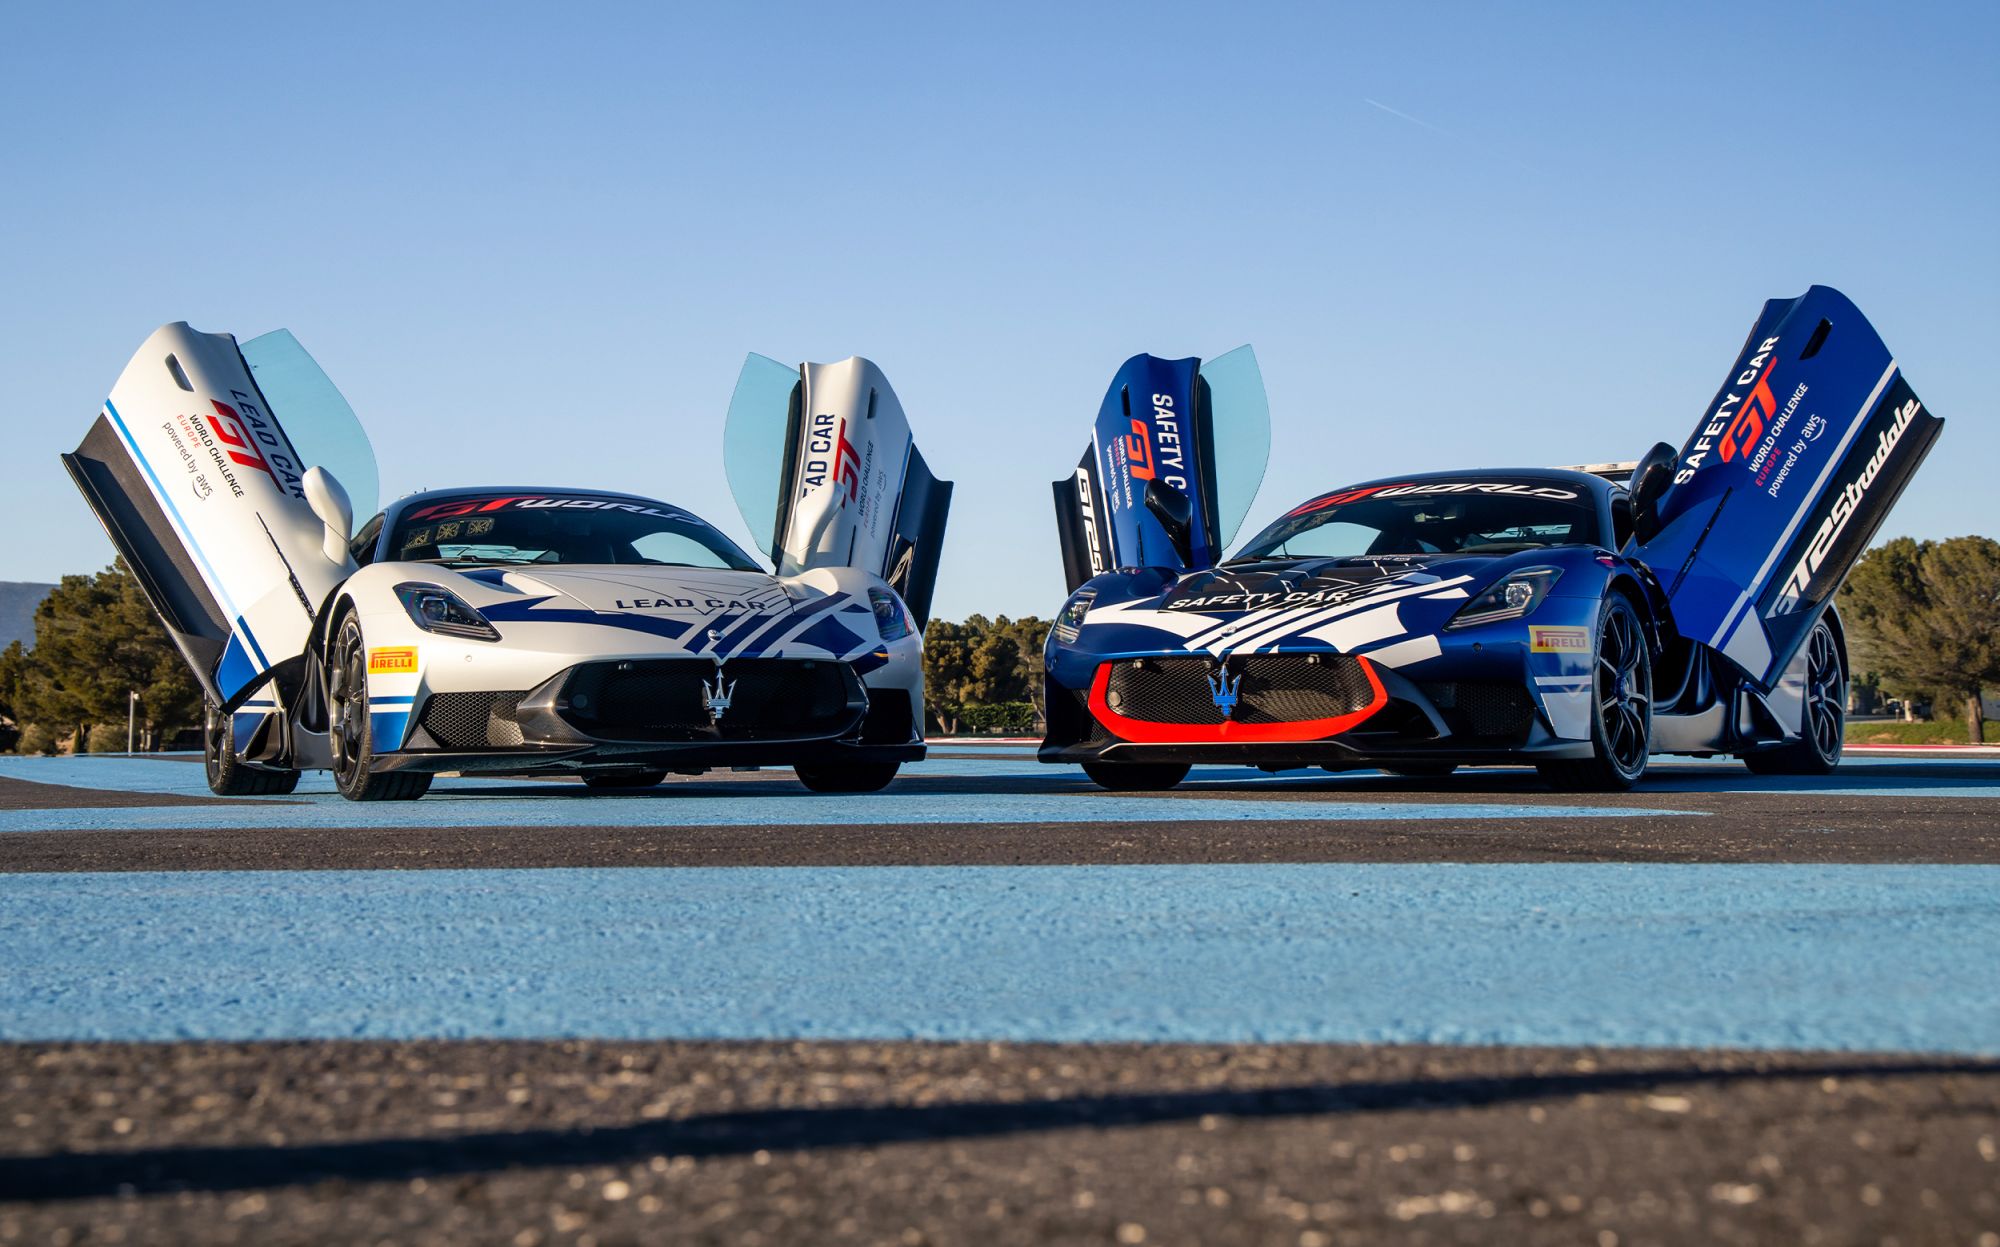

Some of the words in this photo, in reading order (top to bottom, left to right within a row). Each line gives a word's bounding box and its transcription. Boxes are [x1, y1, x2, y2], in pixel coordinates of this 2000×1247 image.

[177, 414, 201, 449] EUROPE
[230, 389, 278, 447] LEAD
[810, 414, 835, 453] CAR
[1152, 393, 1184, 470] SAFETY
[1673, 392, 1741, 485] SAFETY
[1737, 336, 1780, 385] CAR
[1718, 355, 1777, 464] GT
[1748, 435, 1776, 473] WORLD
[1771, 382, 1809, 438] CHALLENGE
[162, 421, 192, 462] powered
[187, 458, 198, 474] by
[196, 474, 214, 497] aws
[189, 414, 213, 447] WORLD
[209, 447, 245, 498] CHALLENGE
[205, 399, 286, 495] GT
[1118, 435, 1126, 465] WORLD
[1125, 418, 1156, 481] GT
[1754, 447, 1782, 488] EUROPE
[1768, 449, 1798, 498] powered
[1791, 439, 1808, 455] by
[1801, 413, 1821, 439] aws
[858, 486, 868, 517] WORLD
[863, 440, 874, 486] CHALLENGE
[1120, 465, 1133, 509] CHALLENGE
[616, 599, 694, 609] LEAD
[705, 600, 768, 610] CAR
[1168, 592, 1281, 609] SAFETY
[1283, 591, 1350, 602] CAR
[371, 651, 413, 668] PIRELLI
[1536, 631, 1586, 648] PIRELLI
